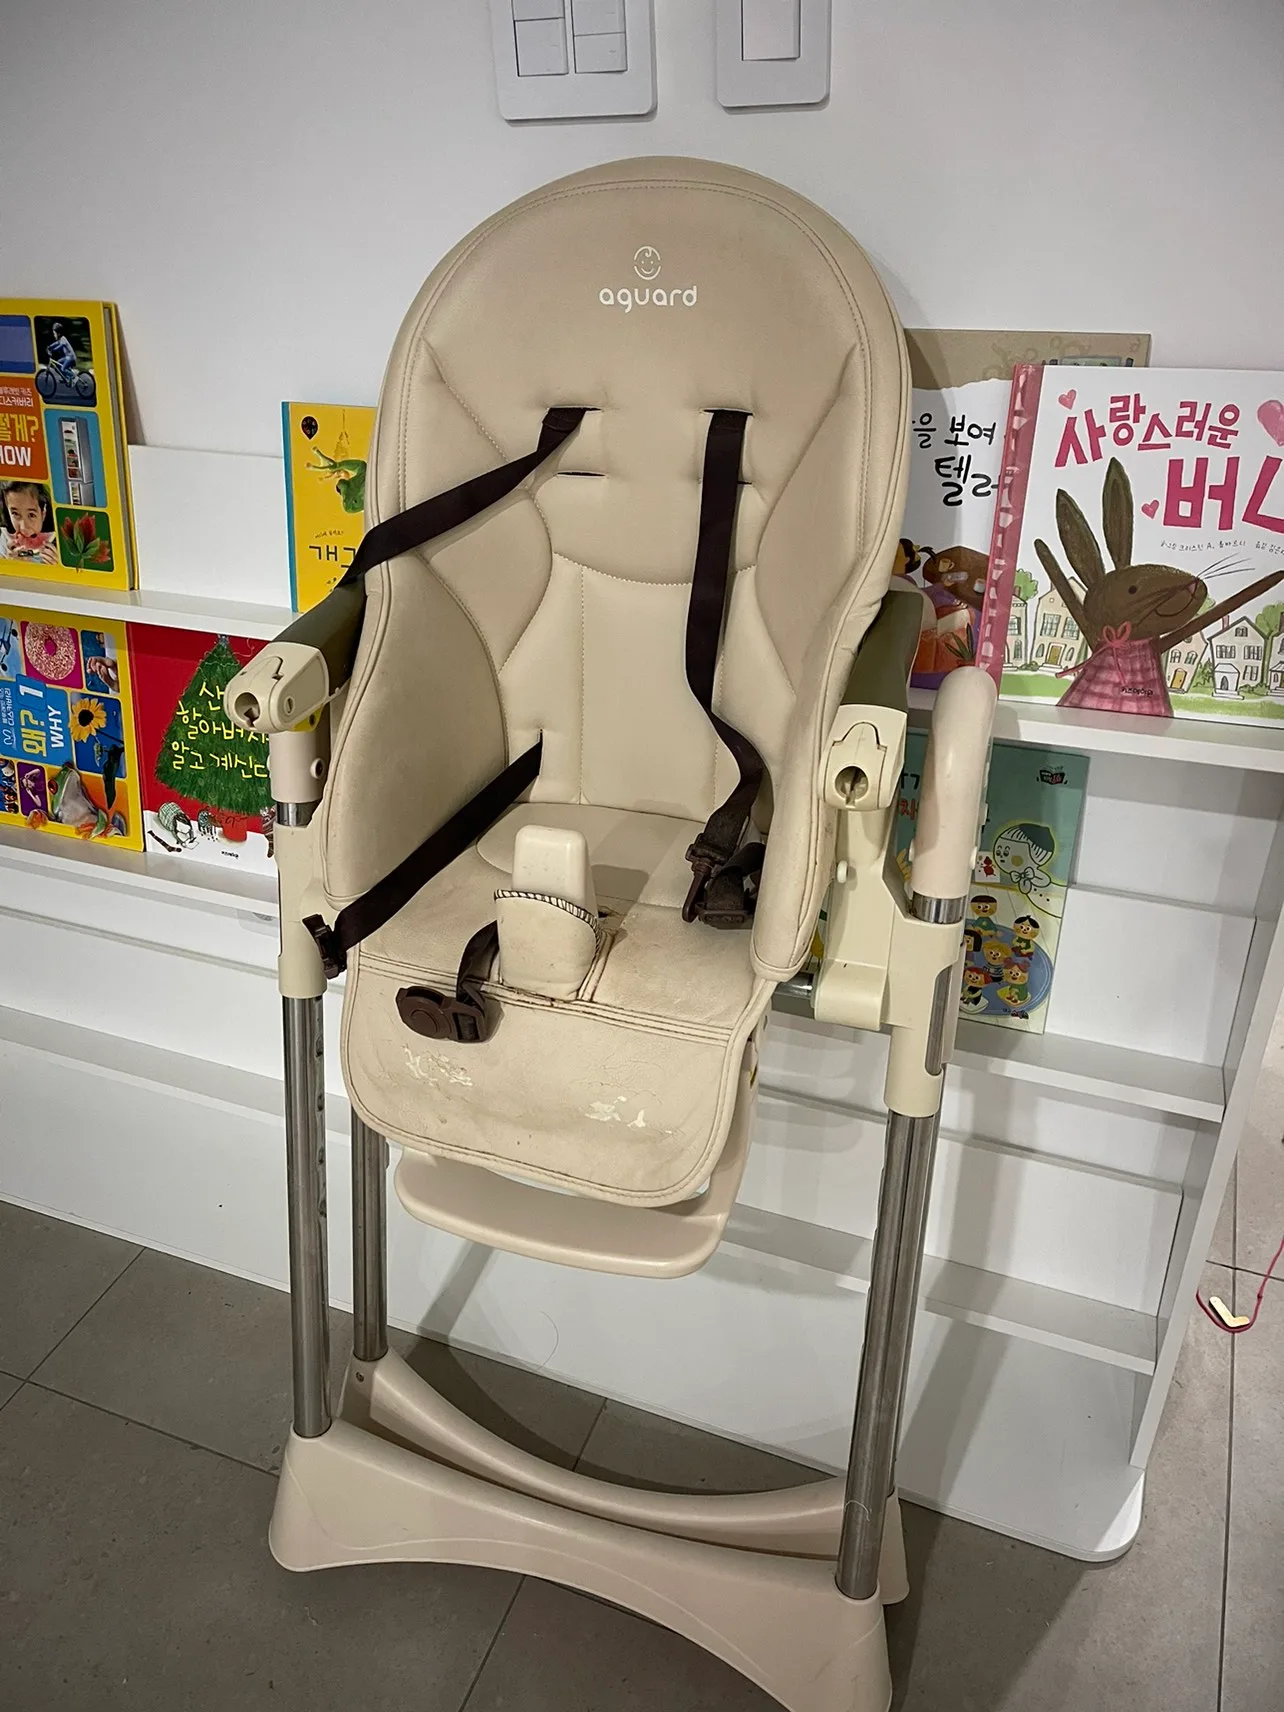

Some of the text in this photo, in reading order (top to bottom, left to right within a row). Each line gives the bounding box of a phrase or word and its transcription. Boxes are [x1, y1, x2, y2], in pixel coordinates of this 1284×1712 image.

[599, 285, 697, 313] aguard
[912, 413, 937, 449] 을
[1055, 393, 1240, 467] 사랑스러운
[5, 687, 15, 726] 디스커버리
[19, 684, 44, 698] 1
[199, 682, 225, 711] 산
[20, 710, 47, 757] 왜?
[47, 705, 65, 749] WHY
[171, 741, 206, 770] 알고
